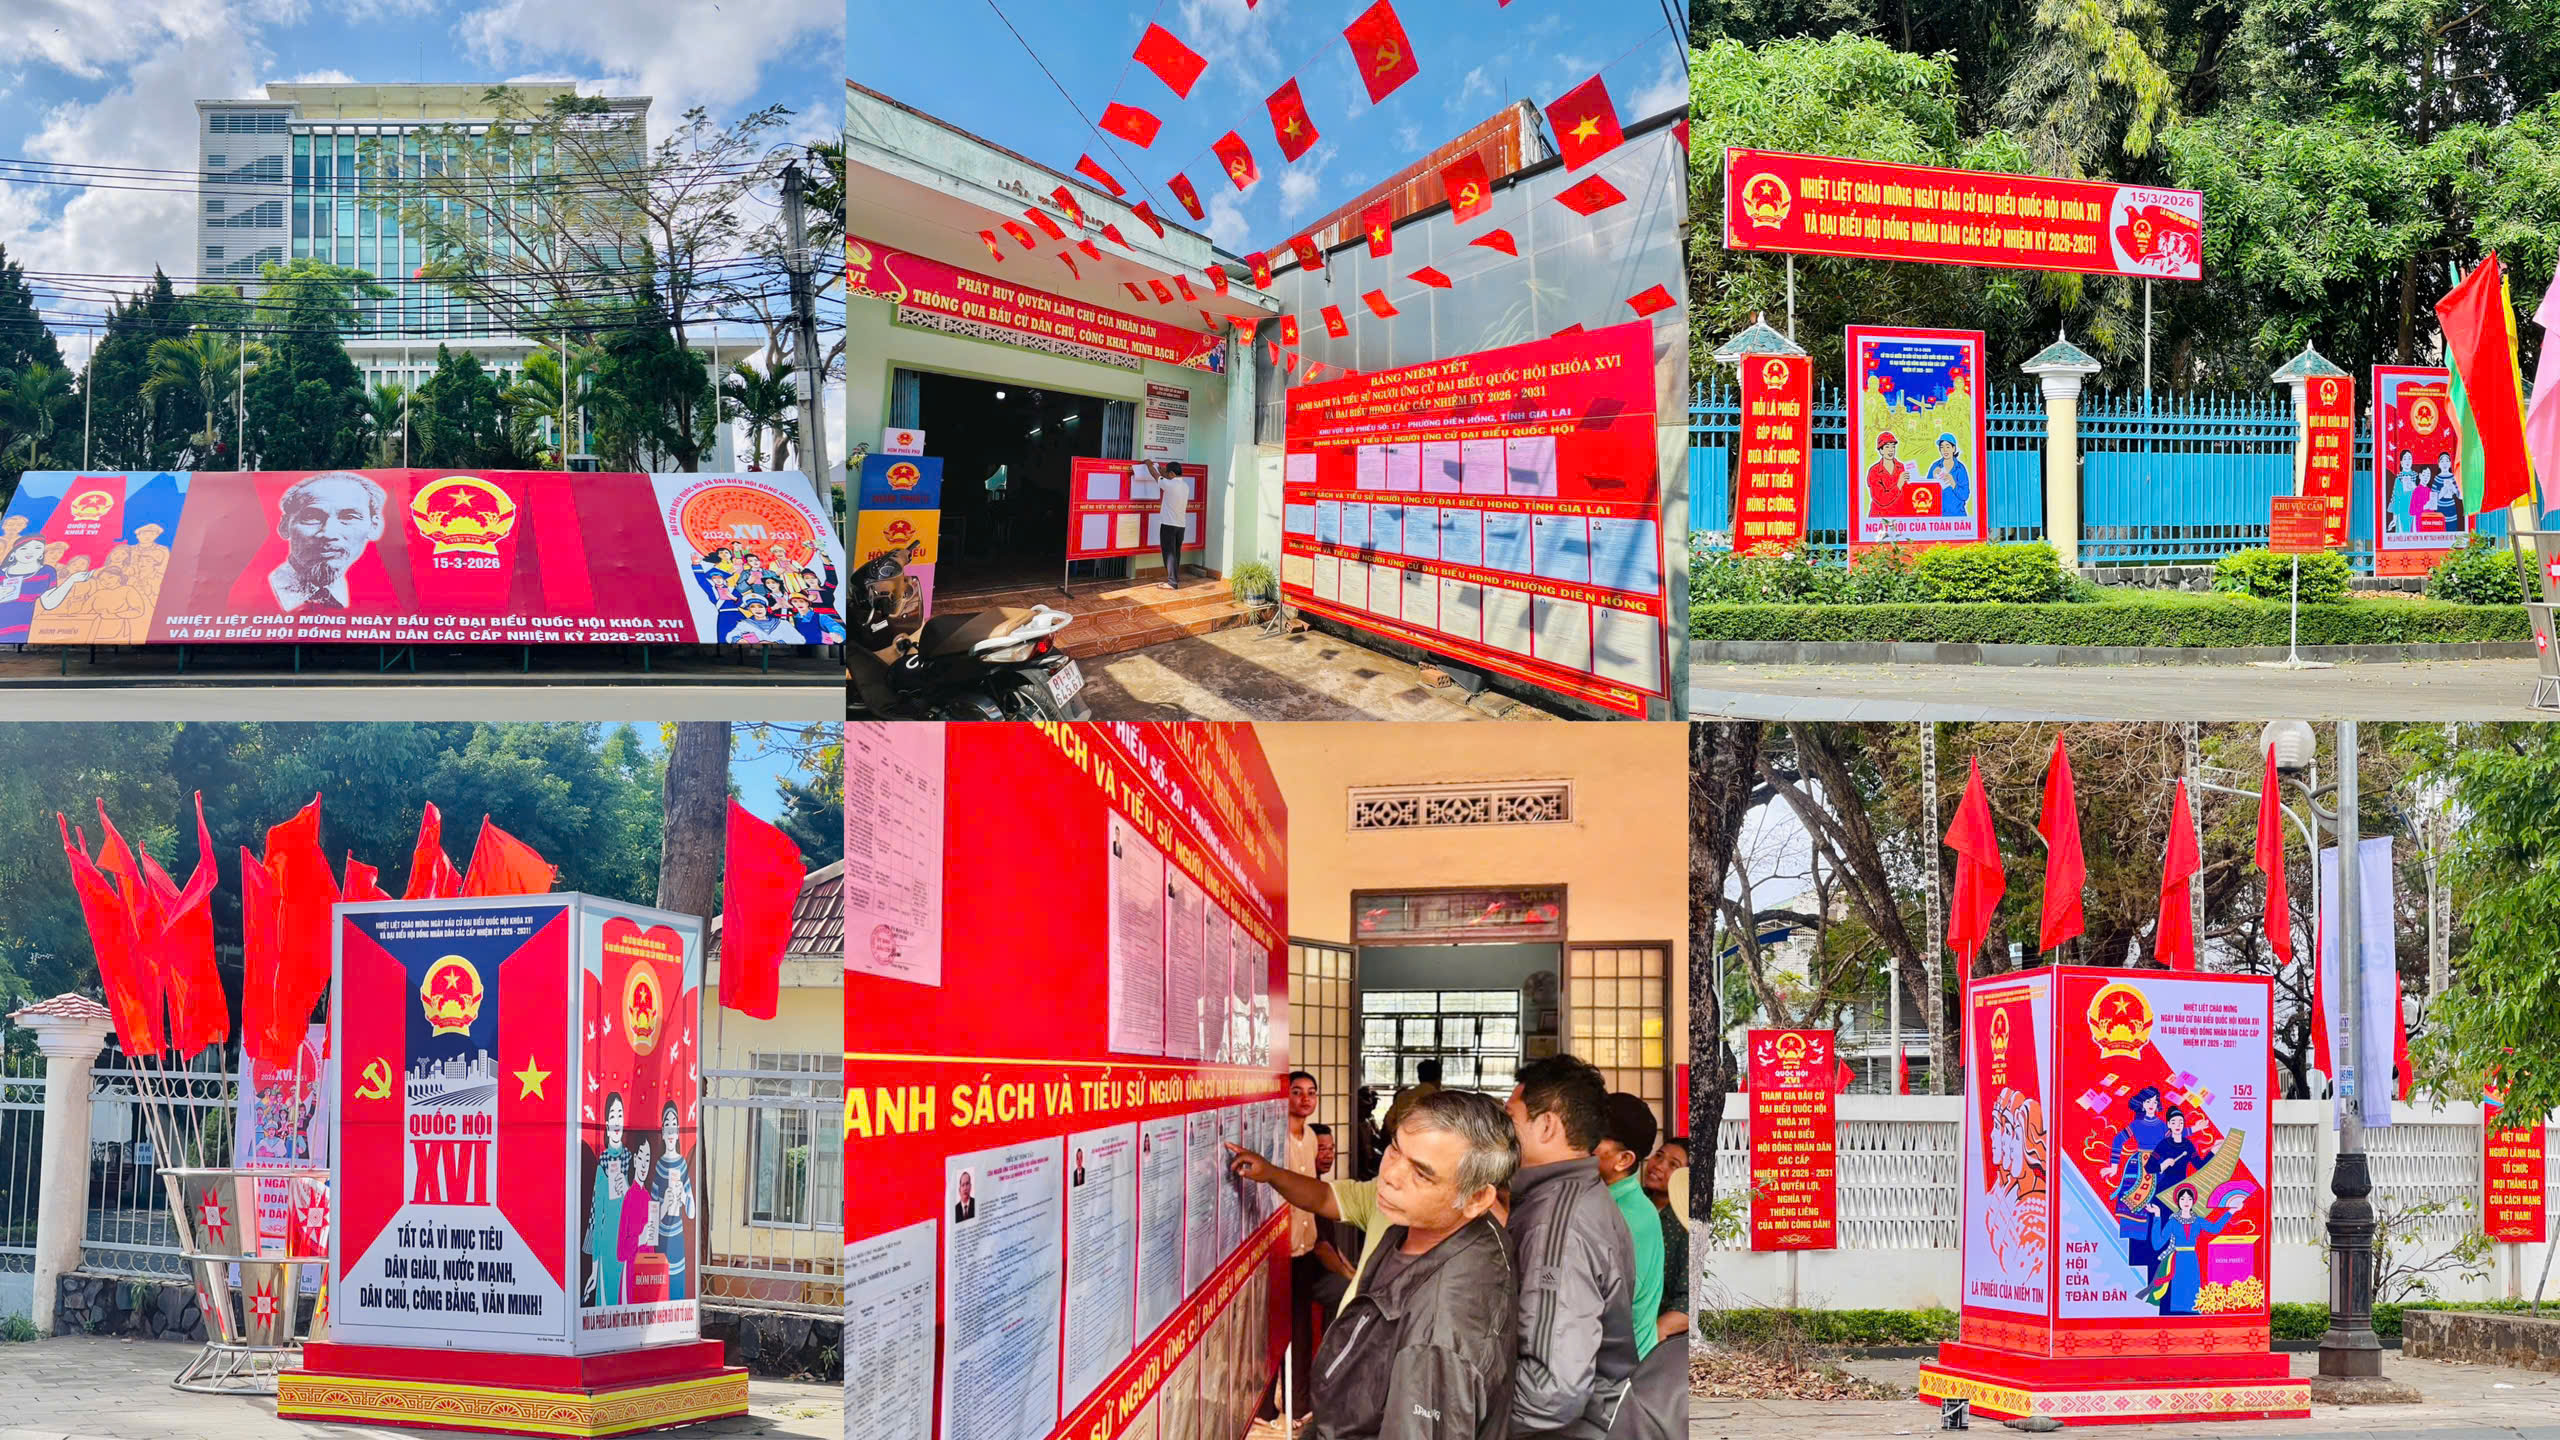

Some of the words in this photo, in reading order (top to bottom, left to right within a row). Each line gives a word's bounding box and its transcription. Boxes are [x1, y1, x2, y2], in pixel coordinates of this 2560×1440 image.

[1800, 175, 1831, 204] NHIỆT
[1832, 177, 1852, 206] LIỆT
[1855, 179, 1880, 204] CHÀO
[1883, 182, 1912, 207] MỪNG
[1914, 185, 1939, 209] NGÀY
[1942, 185, 1960, 211] BẦU
[1963, 187, 1976, 212] CỬ
[1978, 192, 1992, 218] ĐẠI
[1995, 188, 2016, 216] BIỂU
[2018, 192, 2042, 218] QUỐC
[2044, 195, 2058, 222] HỘI
[2061, 197, 2084, 221] KHÓA
[2087, 203, 2100, 223] XVI
[2130, 191, 2194, 207] 15/3/2026
[1804, 209, 1818, 234] VÀ
[1820, 214, 1837, 239] ĐẠI
[1840, 209, 1862, 236] BIỂU
[1864, 214, 1880, 243] HỘI
[1883, 214, 1909, 241] ĐỒNG
[1912, 219, 1938, 243] NHÂN
[1941, 221, 1960, 244] DÂN
[1962, 222, 1981, 246] CÁC
[1983, 220, 2001, 247] CẤP
[2003, 226, 2032, 253] NHIỆM
[2035, 228, 2046, 250] KỲ
[2049, 232, 2096, 254] 2026-2031!
[957, 276, 990, 296] PHÁT
[992, 286, 1015, 303] HUY
[1017, 292, 1051, 312] QUYỀN
[1054, 302, 1074, 319] LÀM
[1076, 308, 1095, 322] CHỦ
[1097, 313, 1114, 328] CỦA
[1116, 318, 1139, 334] NHÂN
[1140, 324, 1157, 338] DÂN
[913, 289, 959, 312] THÔNG
[962, 301, 986, 318] QUA
[989, 306, 1011, 324] BẦU
[1014, 312, 1029, 327] CỬ
[1030, 318, 1053, 334] DÂN
[1055, 324, 1077, 342] CHỦ,
[1079, 328, 1104, 344] CÔNG
[1106, 333, 1129, 353] KHAI,
[1131, 341, 1153, 356] MINH
[1154, 346, 1175, 361] BẠCH
[1371, 373, 1401, 386] BẢNG
[1404, 366, 1437, 380] NIÊM
[1441, 360, 1469, 374] YẾT
[1486, 369, 1520, 386] QUỐC
[1522, 364, 1546, 381] HỘI
[1550, 358, 1591, 376] KHÓA
[1595, 355, 1621, 370] XVI
[1488, 500, 1520, 510] HĐND
[1524, 501, 1554, 512] TỈNH
[1558, 504, 1582, 513] GIA
[1586, 505, 1610, 514] LAI
[2275, 503, 2290, 511] KHU
[703, 531, 732, 540] 2026
[729, 524, 768, 540] XVI
[770, 531, 798, 540] 2031
[1909, 518, 1927, 532] CỦA
[1929, 519, 1952, 532] TOÀN
[1954, 518, 1971, 531] DÂN
[433, 556, 500, 569] 15-3-2026
[1504, 578, 1556, 596] PHƯỜNG
[1600, 593, 1648, 613] HỒNG
[166, 614, 211, 626] NHIỆT
[216, 614, 248, 626] LIỆT
[252, 614, 294, 625] CHÀO
[299, 614, 346, 625] MỪNG
[351, 615, 392, 626] NGÀY
[398, 614, 429, 626] BẦU
[434, 615, 456, 626] CỬ
[459, 616, 485, 629] ĐẠI
[490, 614, 526, 626] BIỂU
[531, 616, 574, 628] QUỐC
[578, 617, 605, 630] HỘI
[610, 617, 653, 628] KHÓA
[657, 619, 684, 628] XVI
[169, 628, 189, 638] VÀ
[194, 629, 220, 640] ĐẠI
[225, 626, 261, 638] BIỂU
[266, 628, 292, 641] HỘI
[298, 626, 341, 639] ĐỒNG
[346, 629, 390, 640] NHÂN
[396, 629, 429, 640] DÂN
[433, 630, 465, 641] CÁC
[470, 628, 502, 641] CẤP
[507, 631, 560, 643] NHIỆM
[564, 630, 584, 641] KỲ
[590, 632, 679, 642] 2026-2031!
[1150, 755, 1168, 793] SỐ:
[1170, 781, 1184, 810] 20
[1094, 753, 1116, 800] VÀ
[1121, 782, 1153, 834] TIỂU
[1157, 818, 1173, 852] SỬ
[1176, 838, 1204, 880] NGƯỜI
[950, 1074, 1035, 1128] SÁCH
[1044, 1075, 1073, 1118] VÀ
[1080, 1066, 1122, 1112] TIỂU
[1127, 1071, 1146, 1108] SỬ
[1150, 1072, 1183, 1104] NGƯỜI
[1186, 1074, 1204, 1100] ỨNG
[1761, 1092, 1782, 1101] THAM
[1784, 1092, 1796, 1101] GIA
[1798, 1089, 1812, 1101] BẦU
[1815, 1090, 1824, 1101] CỬ
[2233, 1085, 2252, 1096] 15/3
[2233, 1101, 2252, 1111] 2026
[410, 1108, 456, 1136] QUỐC
[462, 1111, 491, 1140] HỘI
[410, 1140, 492, 1206] XVI
[398, 1221, 418, 1248] TẤT
[419, 1220, 435, 1249] CẢ
[437, 1226, 448, 1249] VÌ
[450, 1229, 476, 1254] MỤC
[479, 1226, 502, 1251] TIÊU
[2066, 1240, 2098, 1253] NGÀY
[385, 1255, 408, 1279] DÂN
[410, 1256, 440, 1282] GIÀU,
[443, 1258, 475, 1281] NƯỚC
[478, 1262, 516, 1287] MẠNH,
[2066, 1257, 2087, 1271] HỘI
[1981, 1276, 1998, 1298] PHIẾU
[2000, 1280, 2012, 1299] CỦA
[2014, 1281, 2030, 1302] NIỀM
[2032, 1288, 2044, 1303] TIN
[2066, 1272, 2089, 1286] CỦA
[360, 1287, 383, 1308] DÂN
[385, 1280, 410, 1312] CHỦ,
[413, 1288, 443, 1310] CÔNG
[446, 1283, 479, 1315] BẰNG,
[482, 1290, 505, 1314] VĂN
[507, 1294, 542, 1316] MINH!
[2066, 1288, 2098, 1302] TOÀN
[2102, 1288, 2127, 1301] DÂN
[1119, 1354, 1160, 1424] NGƯỜI
[1163, 1327, 1186, 1372] ỨNG
[1203, 1294, 1216, 1326] ĐẠI
